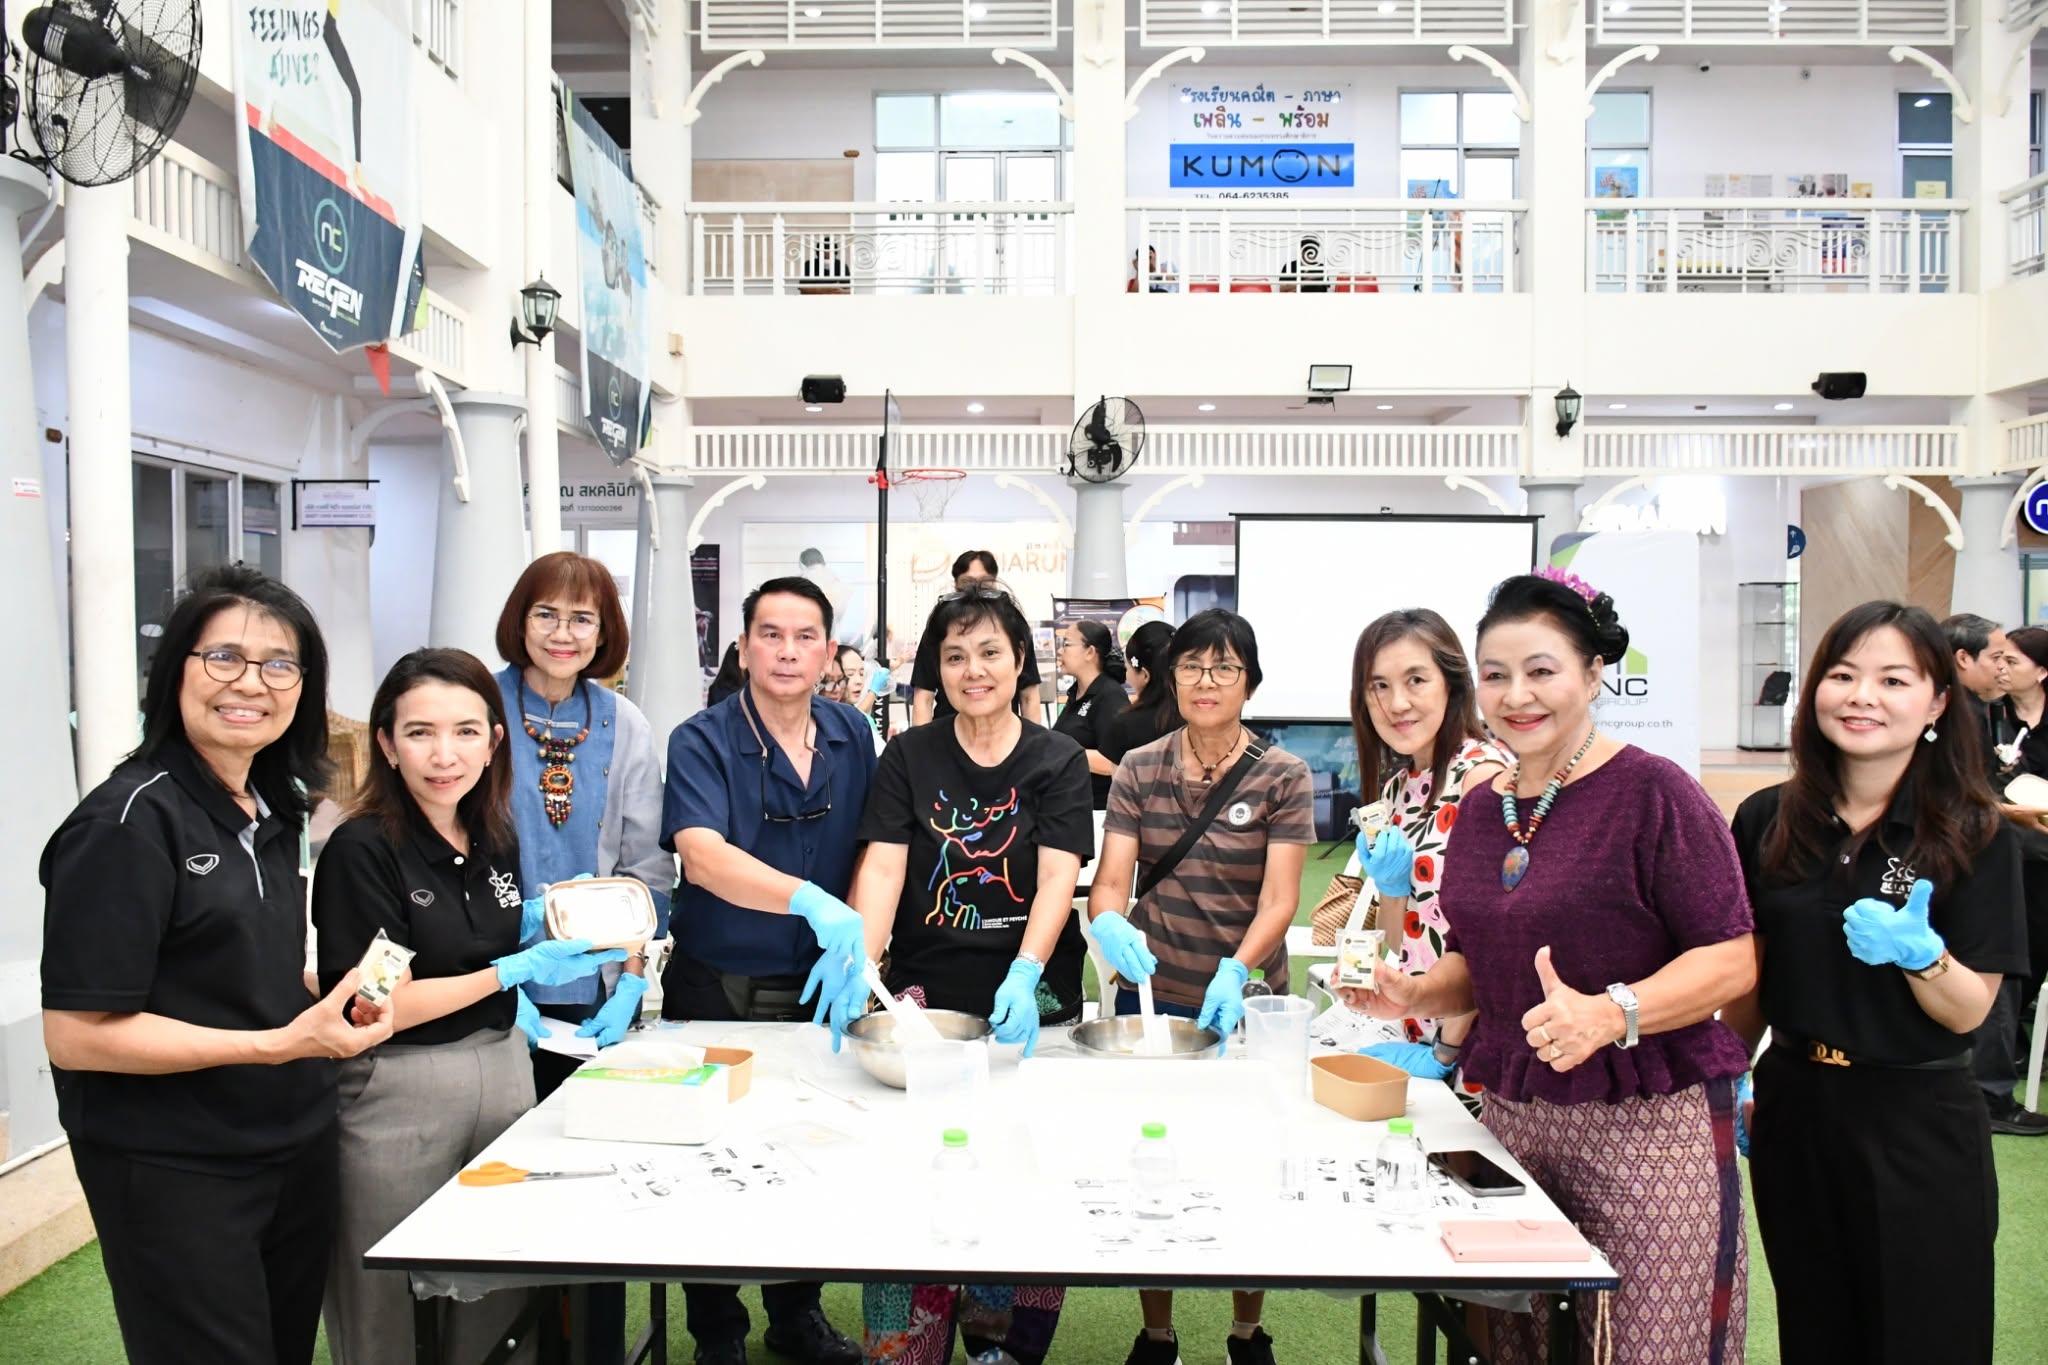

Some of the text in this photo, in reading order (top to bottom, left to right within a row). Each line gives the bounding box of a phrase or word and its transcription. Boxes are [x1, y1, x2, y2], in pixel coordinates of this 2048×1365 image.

[248, 6, 320, 41] FEELINGS
[1193, 105, 1242, 128] เพลิน
[1279, 105, 1329, 128] พร้อม
[1183, 149, 1340, 183] KUMON
[295, 257, 364, 321] REGEN
[579, 482, 636, 497] สหคลินิก
[1602, 677, 1648, 696] NC
